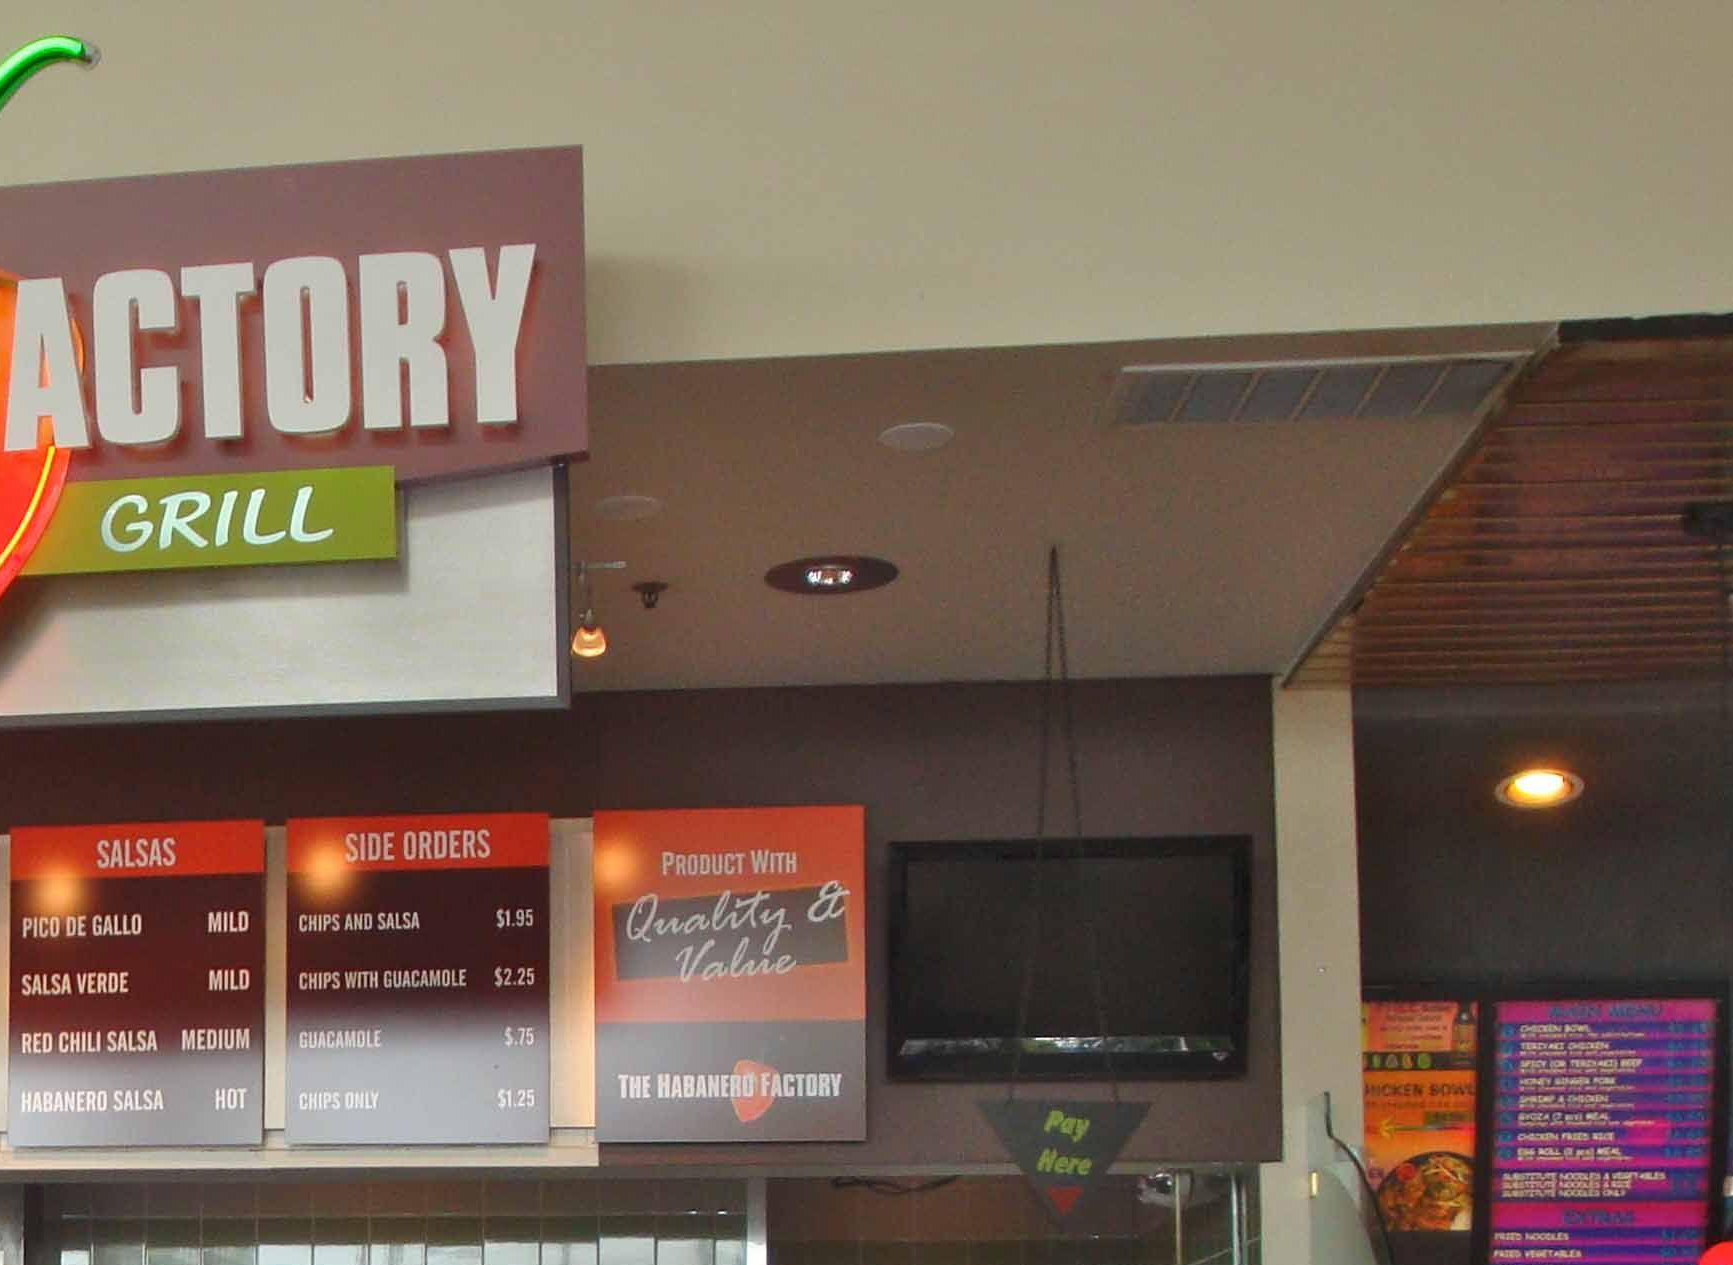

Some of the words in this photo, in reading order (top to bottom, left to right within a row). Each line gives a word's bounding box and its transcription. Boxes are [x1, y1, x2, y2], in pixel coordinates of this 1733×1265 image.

[100, 485, 334, 554] GRILL
[96, 838, 177, 869] SALSAS
[345, 831, 395, 863] SIDE
[403, 829, 490, 860] ORDERS
[662, 851, 745, 875] PRODUCT
[750, 850, 797, 874] WITH
[23, 917, 60, 939] PICO
[66, 916, 86, 937] DE
[92, 914, 142, 937] GALLO
[208, 911, 249, 933] MILD
[299, 913, 340, 932] CHIPS
[344, 912, 373, 931] AND
[378, 911, 420, 930] SALSA
[496, 909, 534, 928] $1.95
[626, 890, 792, 952] Quality
[807, 880, 850, 922] &
[675, 937, 797, 983] Value
[22, 974, 72, 996] SALSA
[77, 972, 129, 993] VERDE
[208, 969, 250, 991] MILD
[299, 972, 340, 991] CHIPS
[345, 971, 378, 989] WITH
[383, 969, 467, 989] GUACAMOLE
[494, 967, 535, 987] $2.25
[22, 1032, 53, 1054] RED
[58, 1031, 101, 1053] CHILI
[107, 1030, 157, 1052] SALSA
[181, 1028, 250, 1051] MEDIUM
[299, 1029, 381, 1049] GUACAMOLE
[505, 1027, 534, 1046] $.75
[618, 1074, 651, 1099] THE
[657, 1073, 754, 1099] HABANERO
[760, 1073, 842, 1098] FACTORY
[1365, 1083, 1423, 1096] HICKEN
[21, 1090, 107, 1113] HABANERO
[113, 1089, 164, 1112] SALSA
[215, 1088, 247, 1110] HOT
[299, 1092, 340, 1111] CHIPS
[345, 1091, 379, 1110] ONLY
[497, 1089, 535, 1109] $1.25
[1043, 1110, 1090, 1143] Pay
[1036, 1148, 1093, 1176] Here
